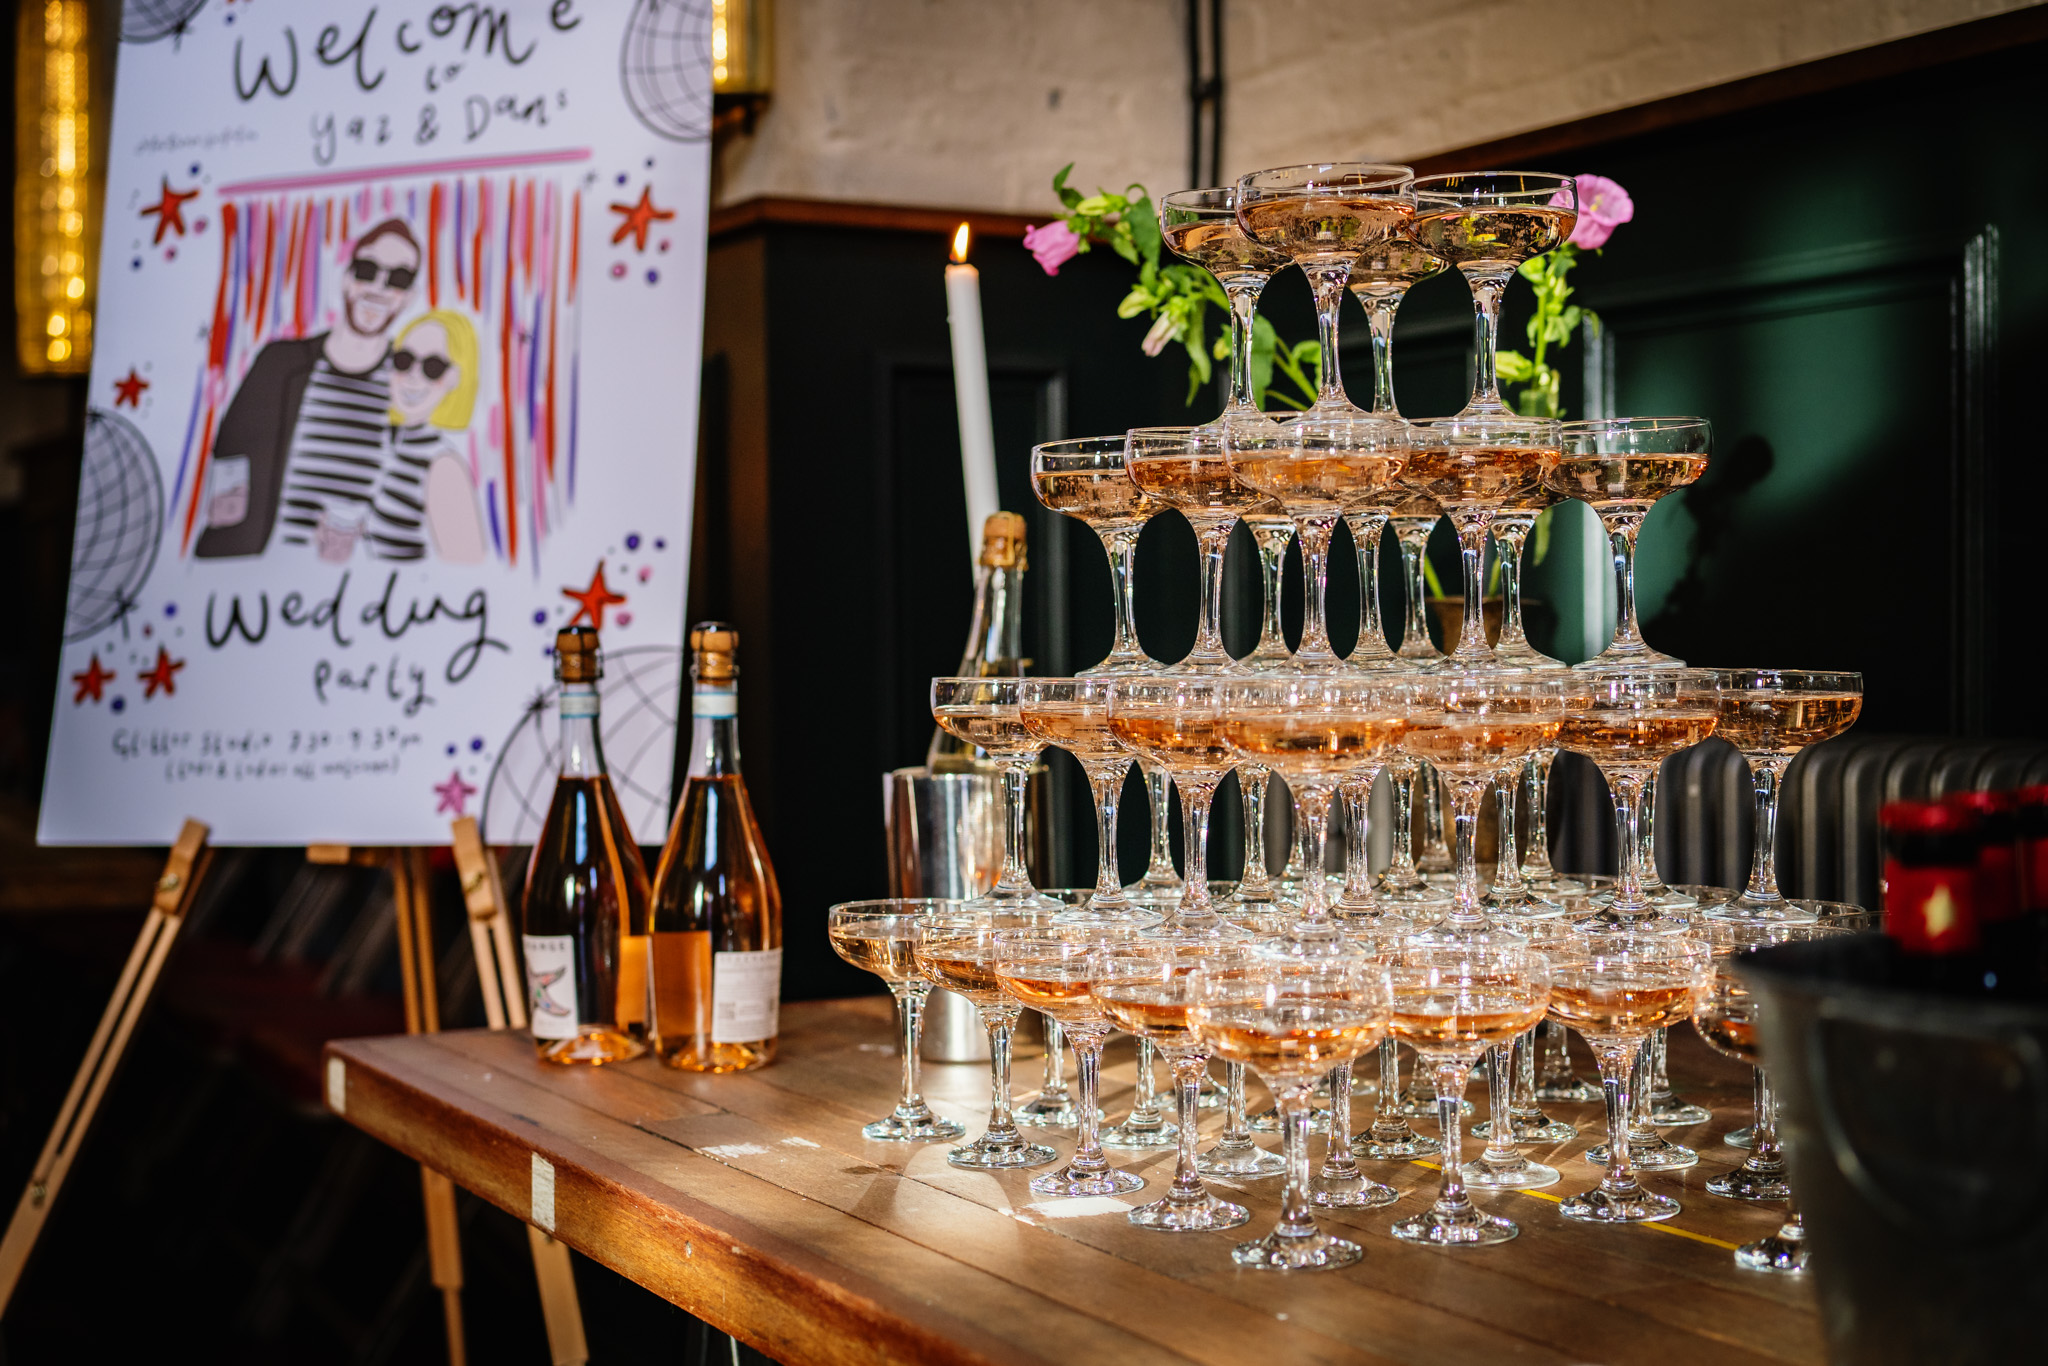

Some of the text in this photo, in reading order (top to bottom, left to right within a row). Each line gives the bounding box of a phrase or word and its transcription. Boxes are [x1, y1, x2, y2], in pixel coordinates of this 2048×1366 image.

[233, 0, 581, 101] Welcome
[414, 102, 440, 146] &
[205, 568, 513, 685] Wedding
